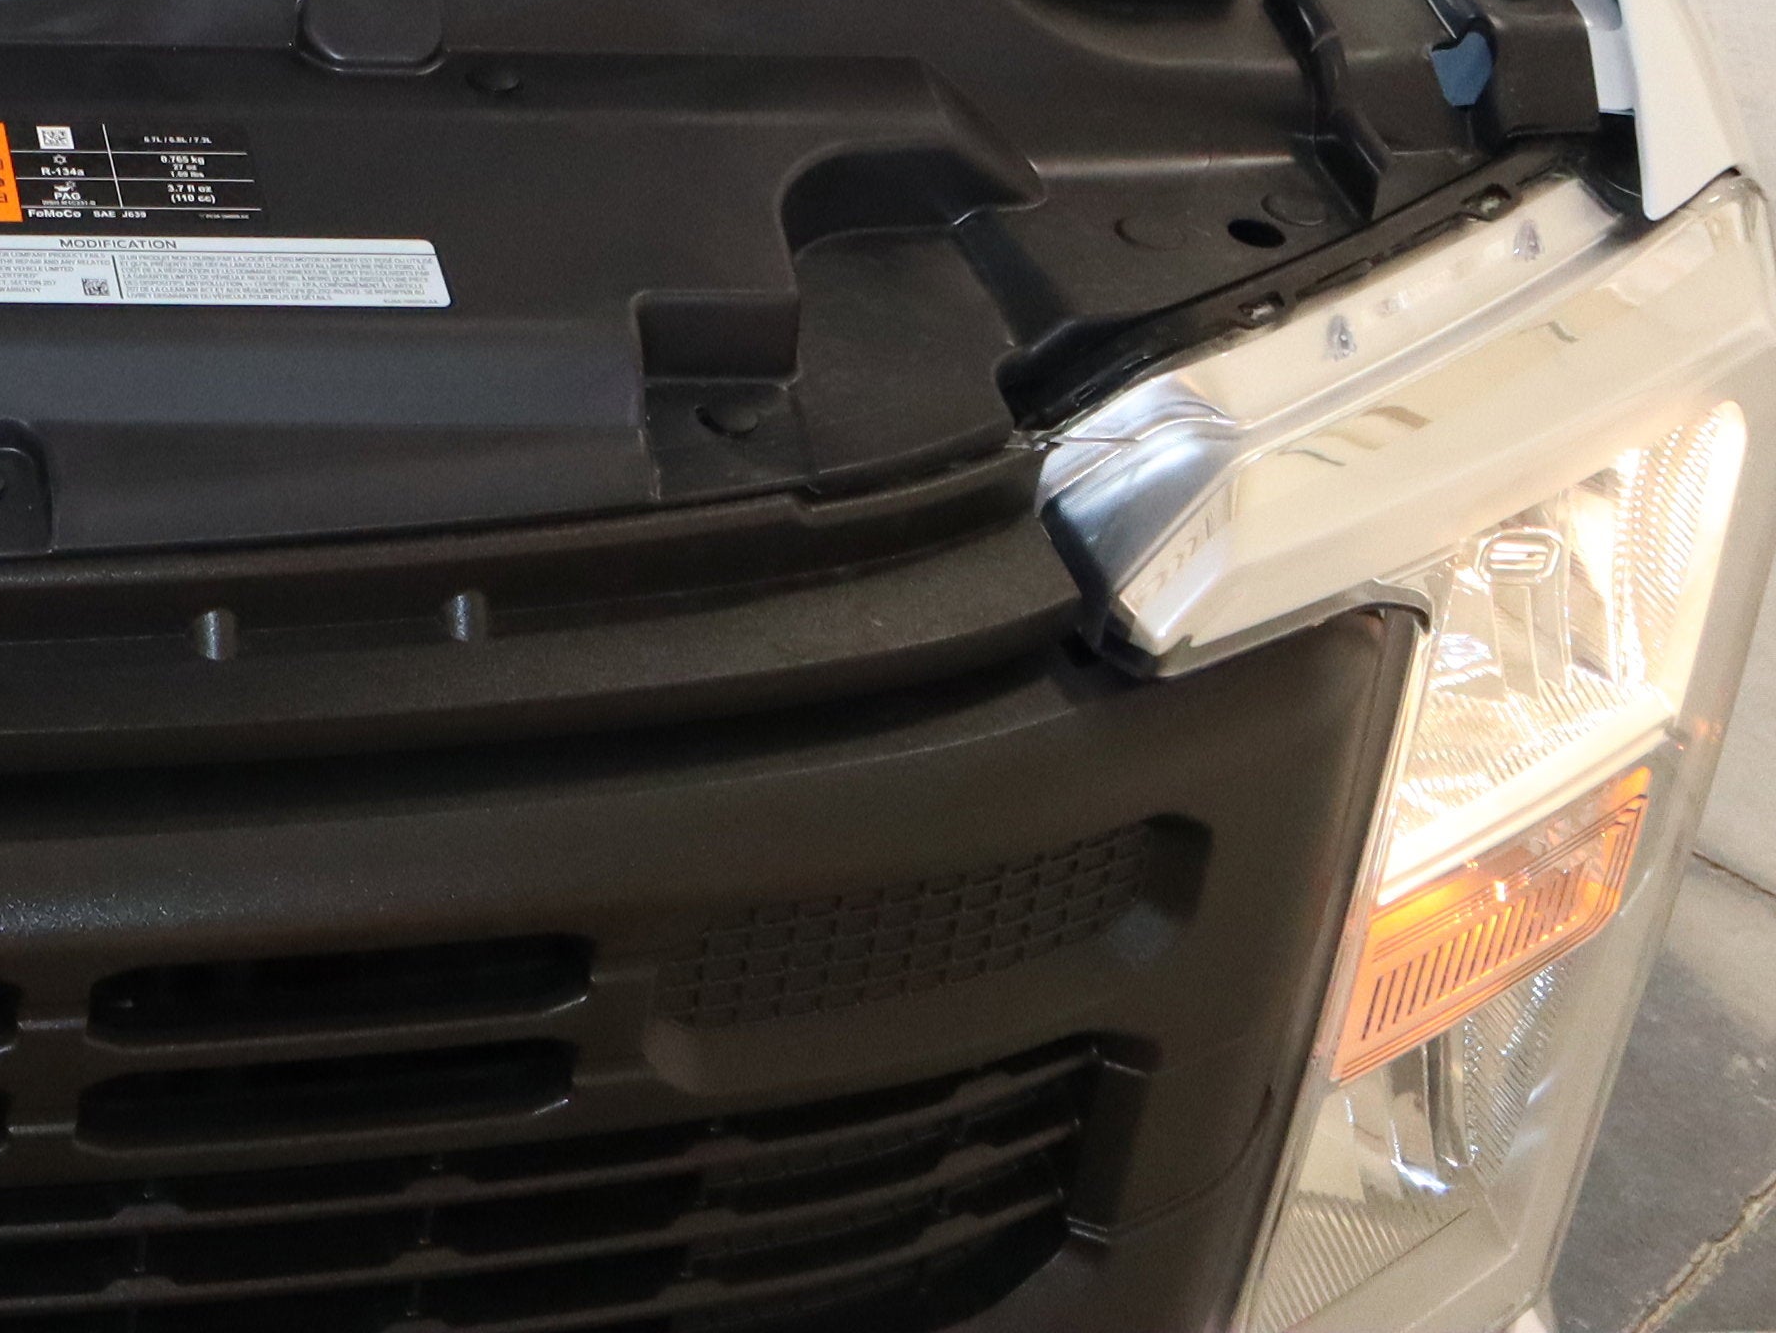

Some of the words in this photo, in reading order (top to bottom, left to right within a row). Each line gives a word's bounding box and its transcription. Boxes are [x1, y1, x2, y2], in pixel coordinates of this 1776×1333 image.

[191, 155, 205, 166] kg
[40, 167, 86, 176] R-134a
[167, 184, 184, 193] 3.7
[53, 191, 82, 200] PAG
[170, 194, 195, 204] (110
[27, 209, 82, 218] FoMoCo
[92, 210, 117, 219] SAE
[121, 211, 147, 219] J639
[59, 238, 178, 249] MODIFICATION
